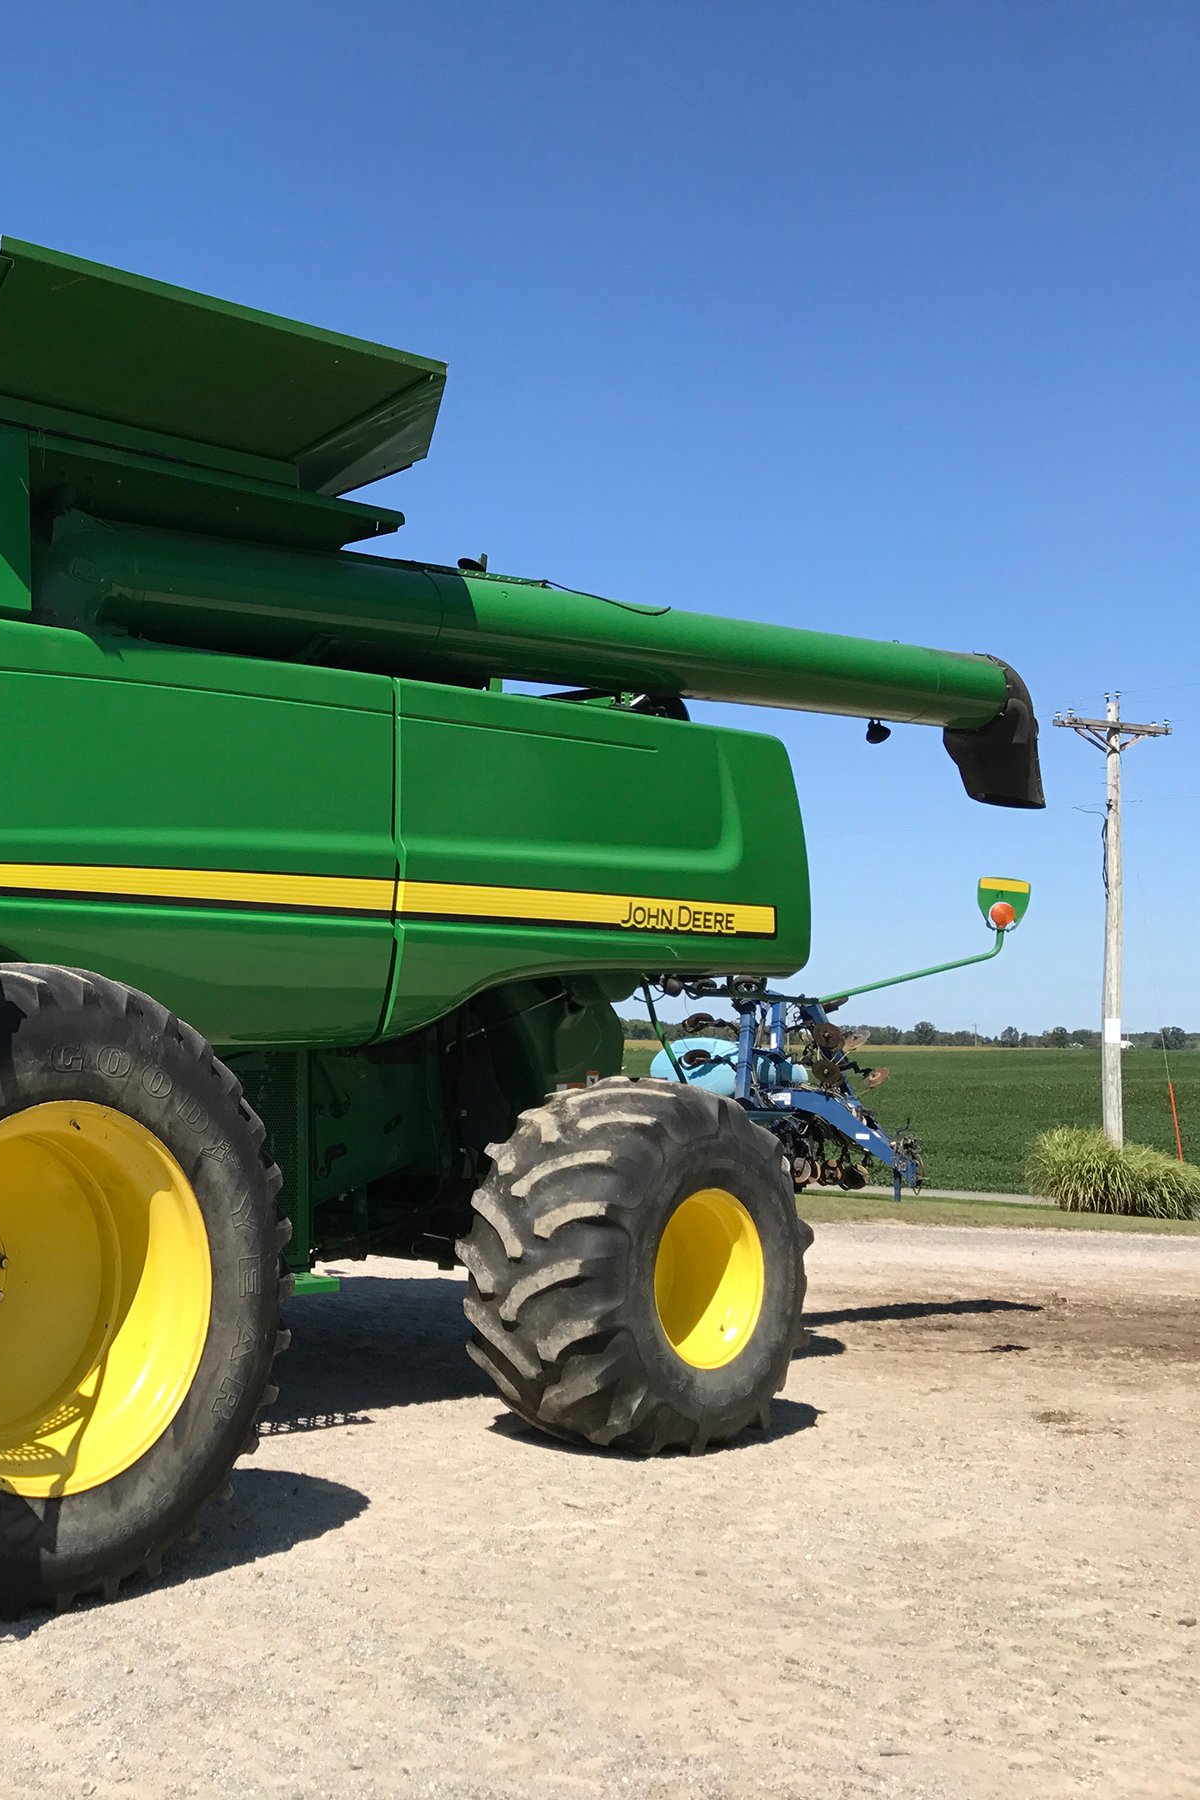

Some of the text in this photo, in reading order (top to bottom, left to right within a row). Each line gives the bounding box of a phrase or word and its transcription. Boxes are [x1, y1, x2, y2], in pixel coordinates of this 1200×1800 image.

[621, 902, 735, 931] JOHN DEERE
[50, 1043, 264, 1422] GOODYEAR
